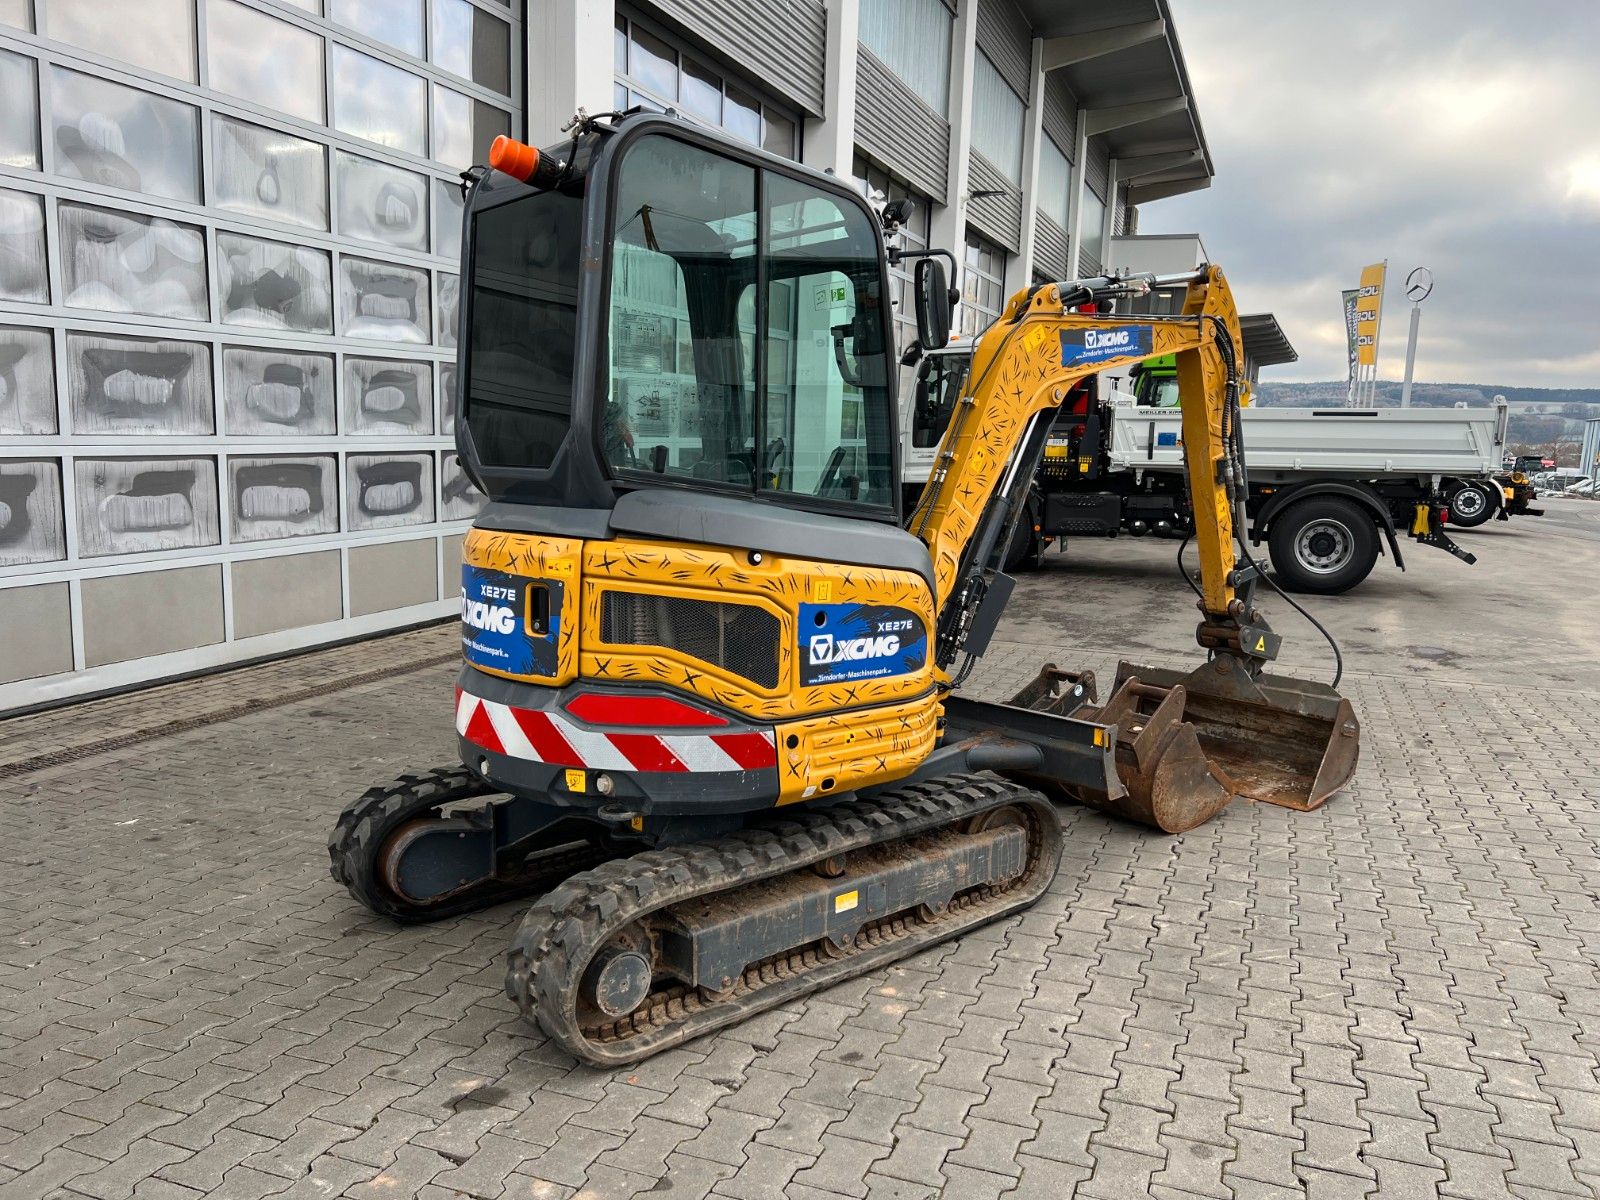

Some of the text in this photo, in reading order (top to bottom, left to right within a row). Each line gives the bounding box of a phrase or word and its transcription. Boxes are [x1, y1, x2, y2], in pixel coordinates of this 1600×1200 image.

[1096, 330, 1129, 347] XCMG
[480, 584, 516, 601] XE27E
[466, 599, 515, 634] XCMG
[878, 620, 913, 632] XE27E
[832, 635, 900, 662] XCMG
